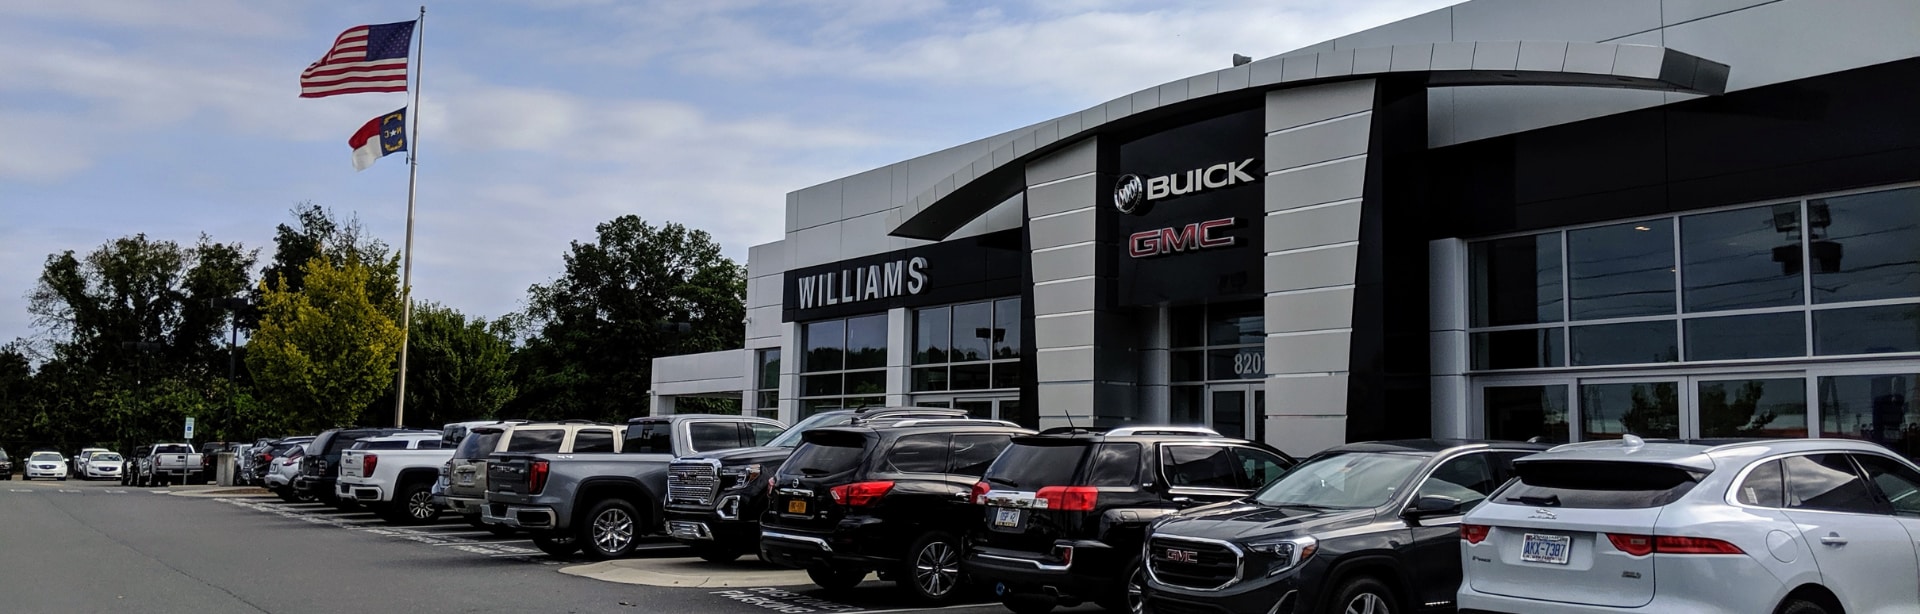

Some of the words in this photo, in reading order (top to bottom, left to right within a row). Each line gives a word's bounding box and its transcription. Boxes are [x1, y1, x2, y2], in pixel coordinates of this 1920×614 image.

[1147, 158, 1255, 200] BUICK
[1129, 217, 1235, 258] GMC
[798, 256, 928, 310] WILLIAMS
[1234, 352, 1265, 375] 820
[1167, 548, 1198, 563] GMC
